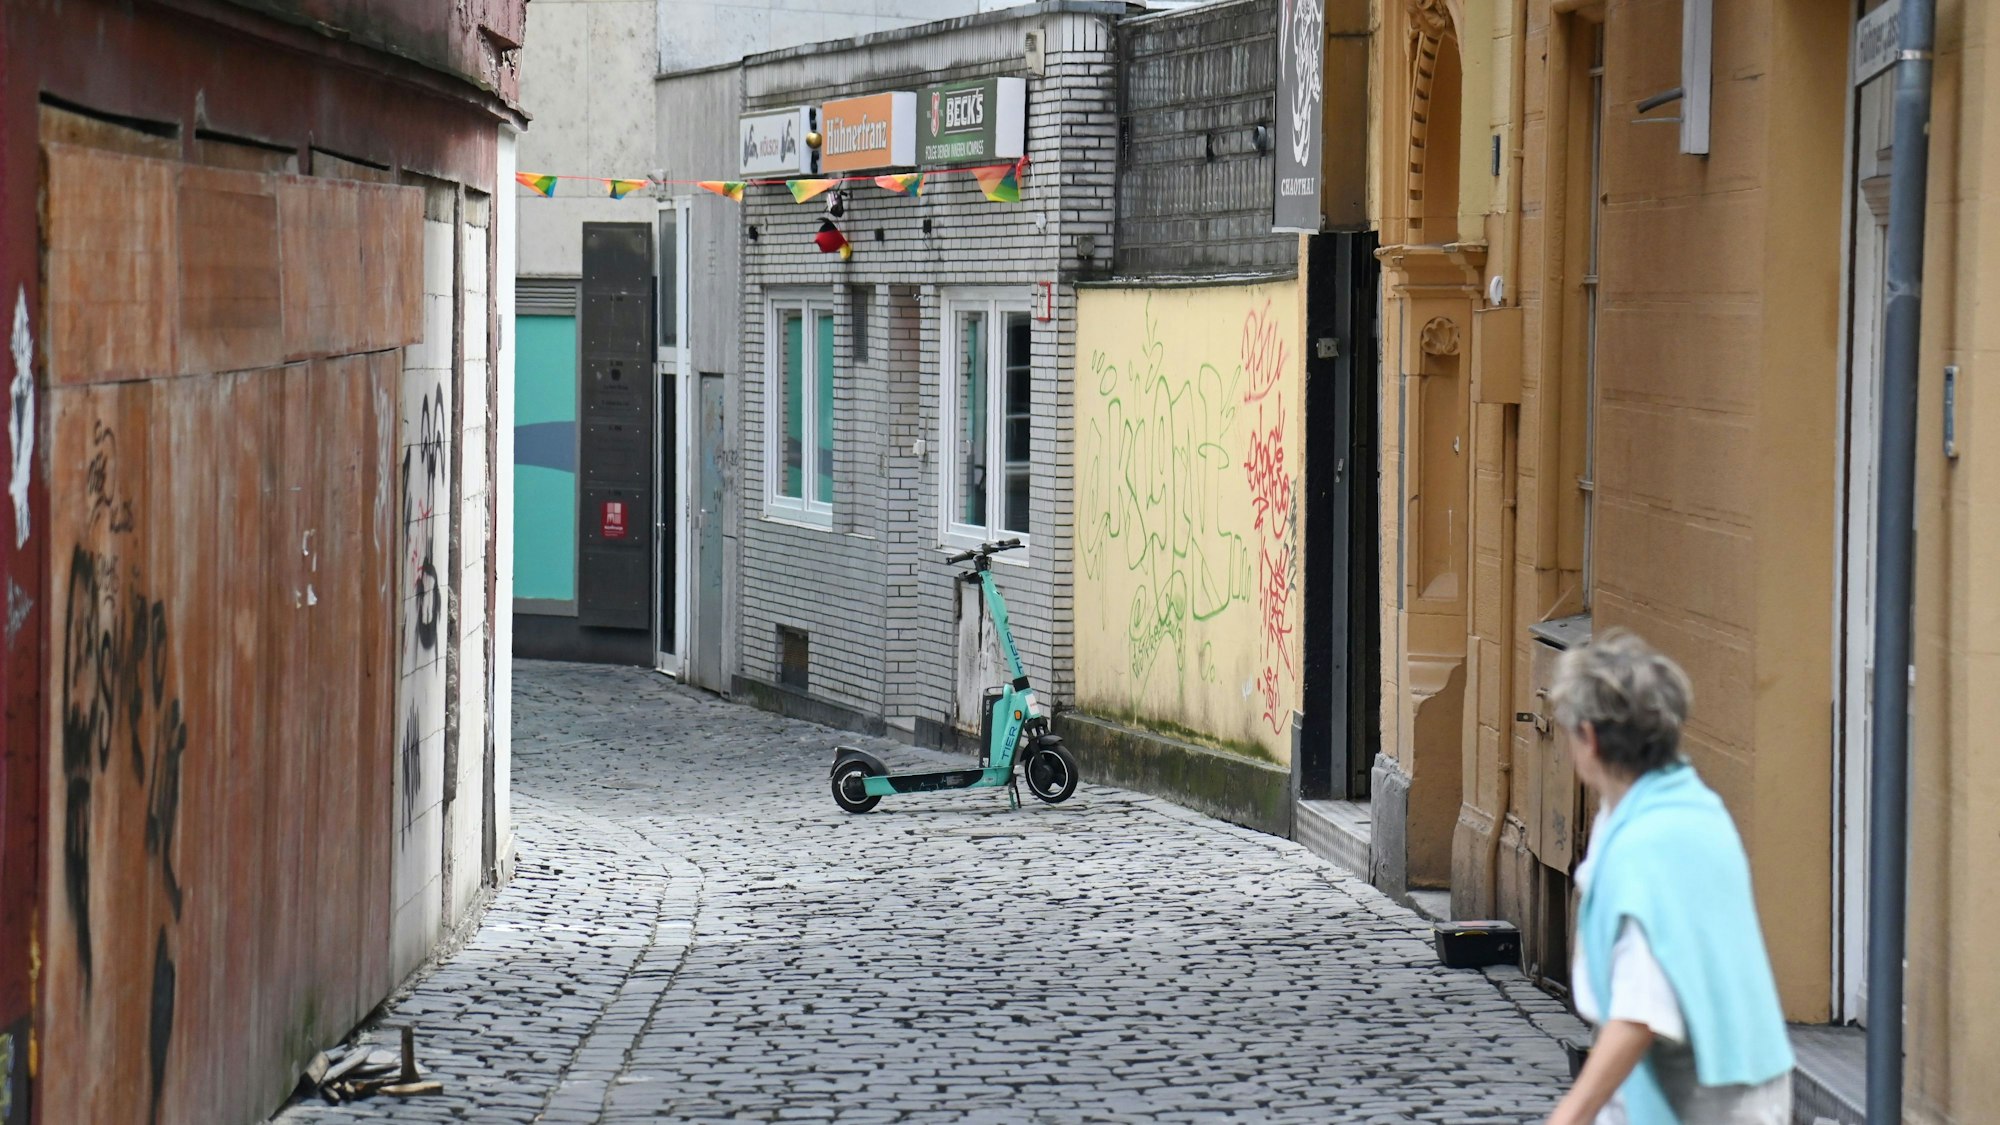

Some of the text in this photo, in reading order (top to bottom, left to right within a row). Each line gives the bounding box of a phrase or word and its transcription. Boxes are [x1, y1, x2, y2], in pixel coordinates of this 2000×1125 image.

[946, 88, 984, 128] BECK'S
[826, 113, 887, 156] Hühnerfranz
[1002, 726, 1017, 760] TIER
